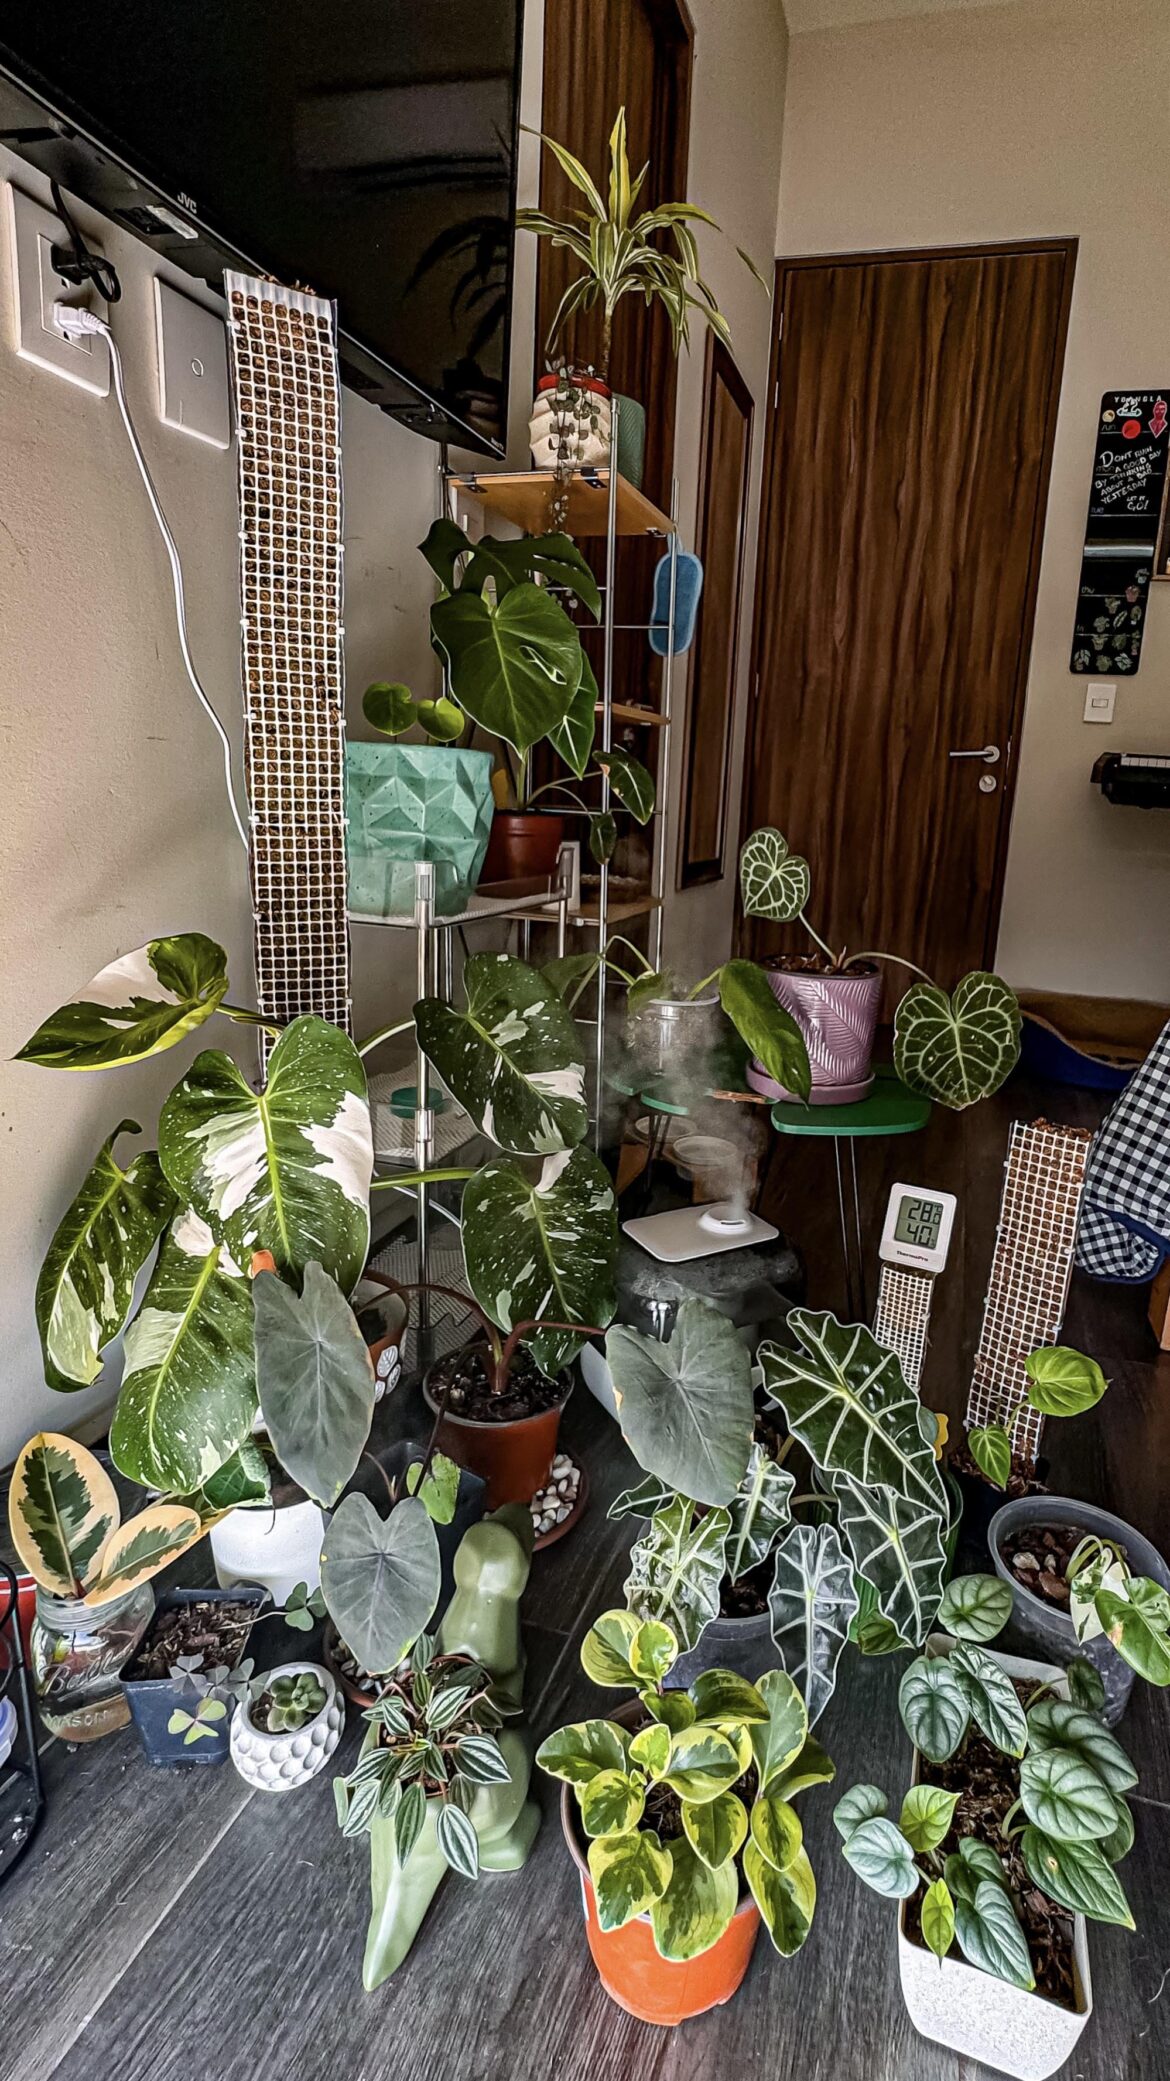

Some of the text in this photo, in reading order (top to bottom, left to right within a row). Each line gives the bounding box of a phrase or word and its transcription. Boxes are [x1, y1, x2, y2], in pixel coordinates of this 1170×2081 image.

[177, 191, 197, 214] JVC
[1114, 395, 1162, 403] YONGLA
[1123, 456, 1146, 470] GOOD
[1148, 449, 1161, 460] DAY
[1095, 462, 1151, 488] BY THINKING
[1100, 480, 1124, 496] ABOUT
[1136, 468, 1152, 479] BAD
[1100, 478, 1146, 504] YESTERDAY
[1127, 500, 1149, 511] GO!
[907, 1222, 932, 1245] 40
[896, 1250, 928, 1261] ThermoPro
[39, 1648, 133, 1695] Ball
